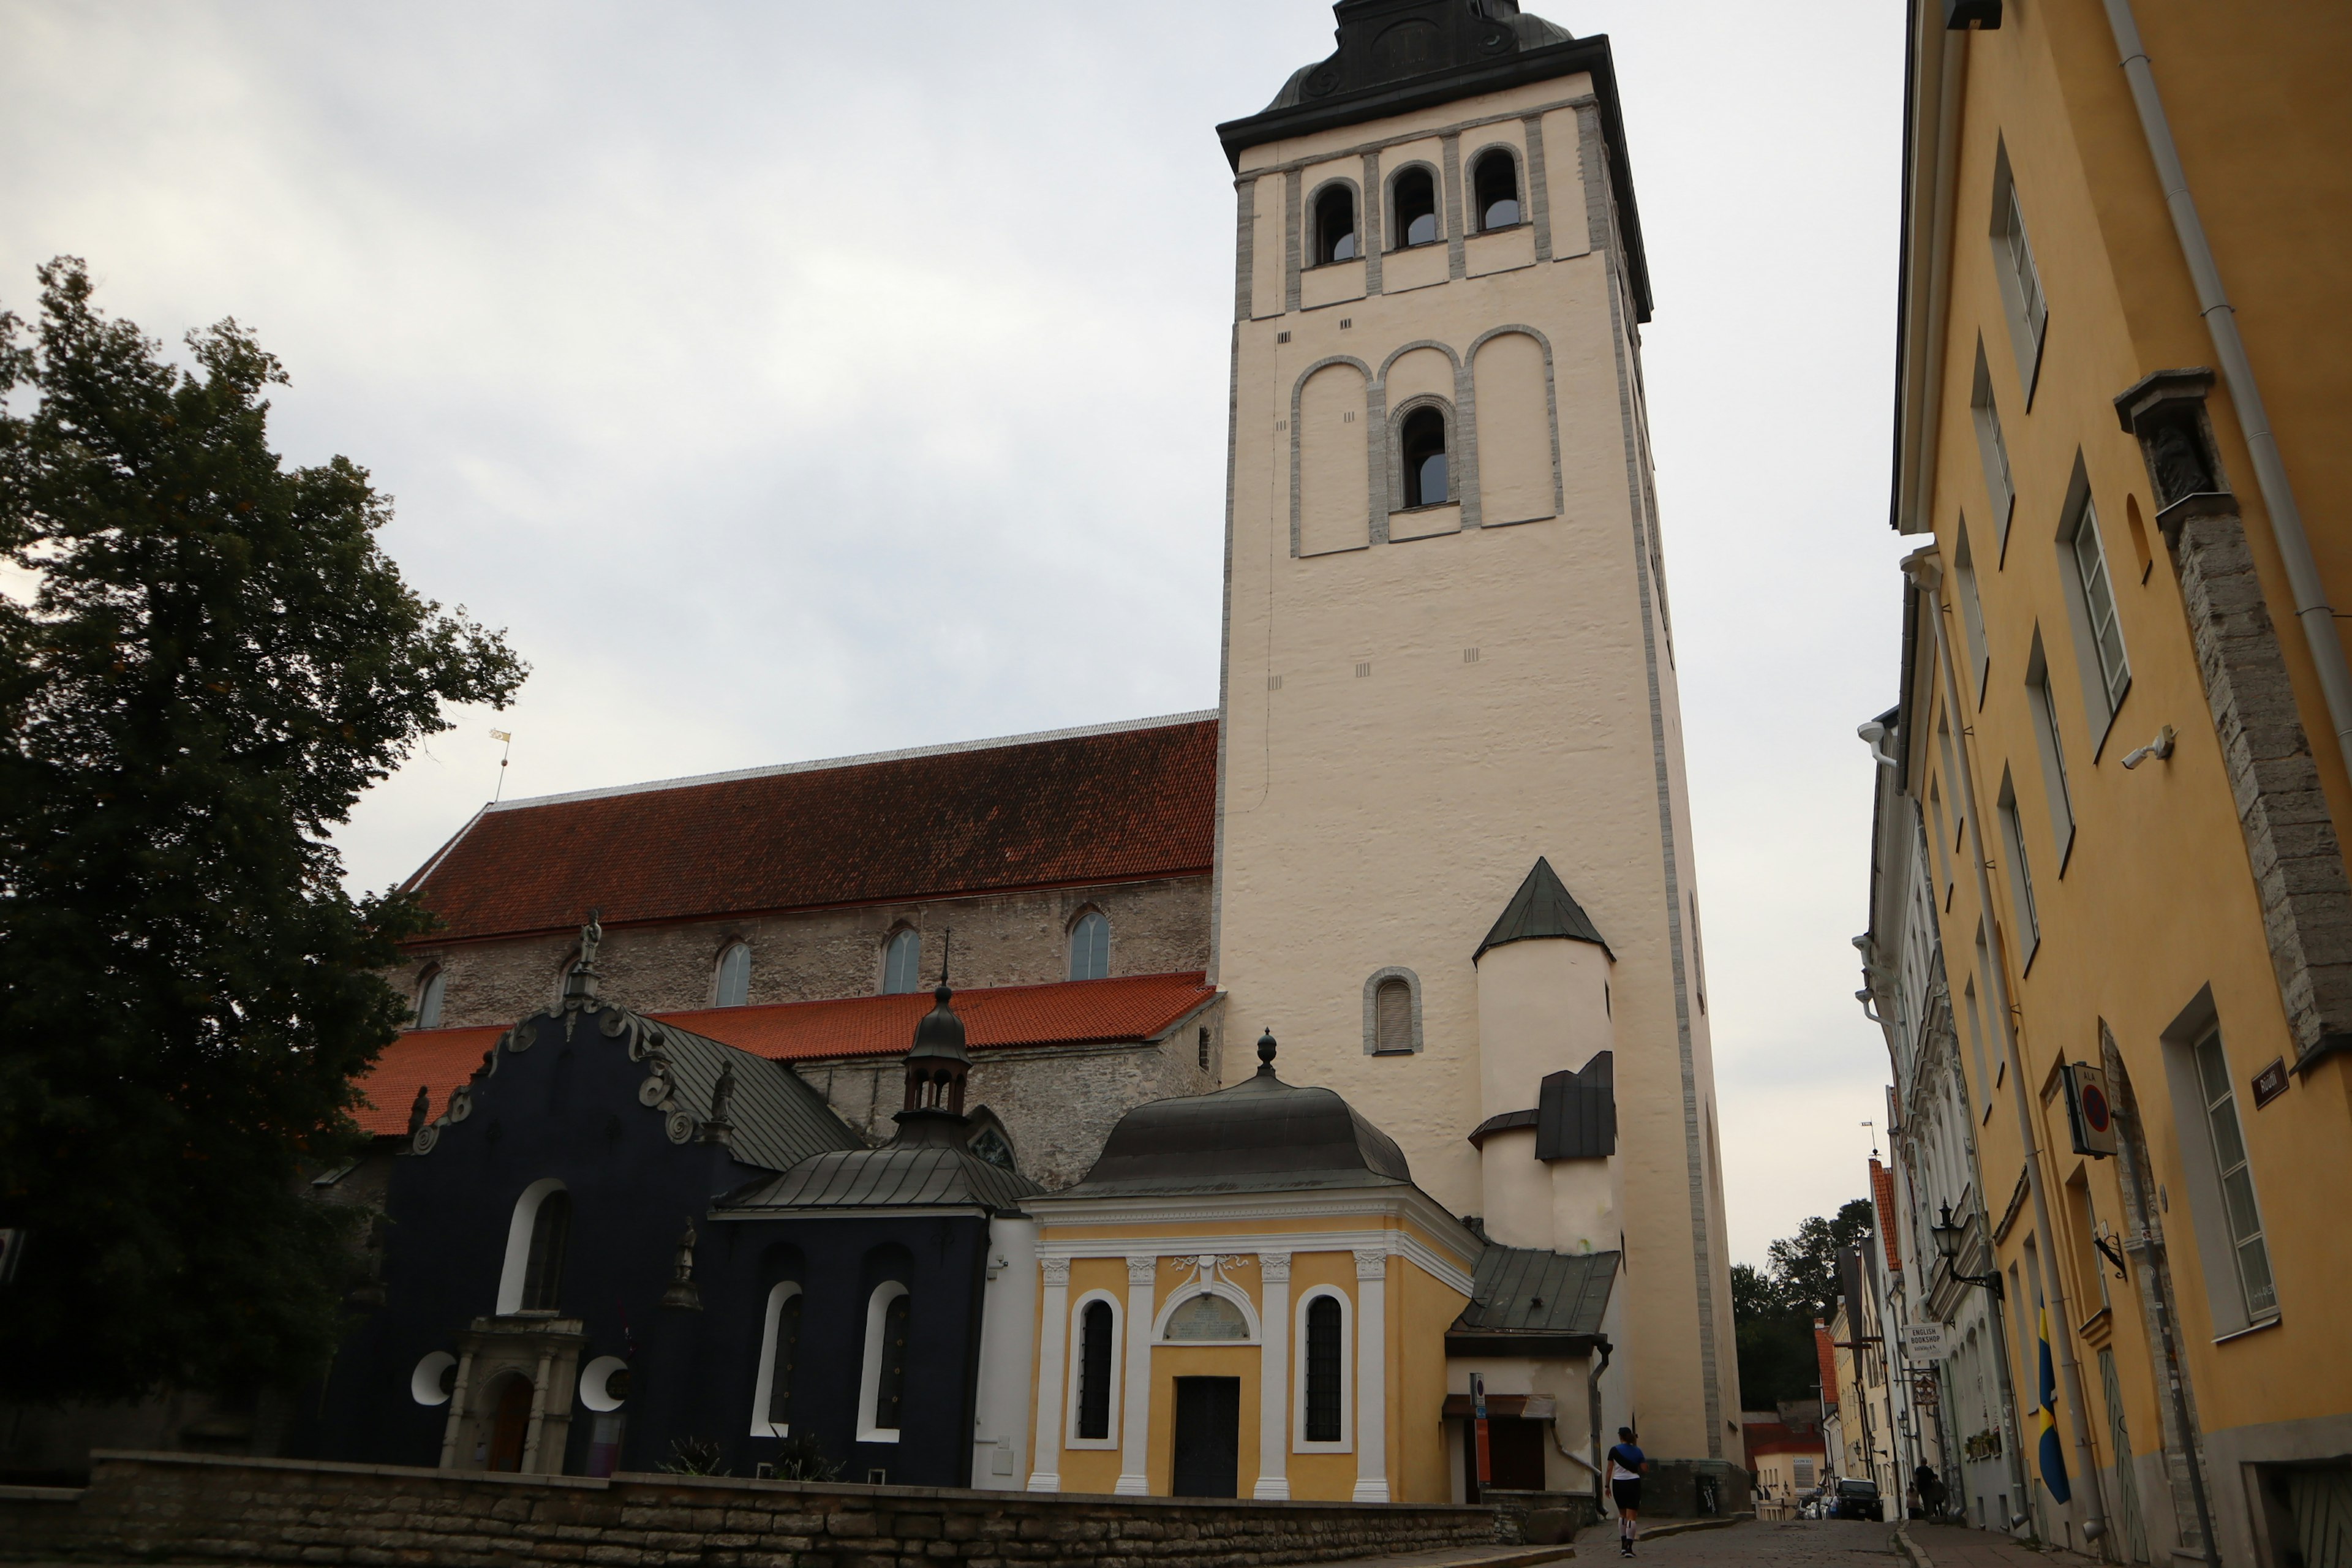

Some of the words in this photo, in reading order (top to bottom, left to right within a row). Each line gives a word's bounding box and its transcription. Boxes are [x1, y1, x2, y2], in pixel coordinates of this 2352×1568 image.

[2084, 1071, 2096, 1082] ALA
[2260, 1070, 2278, 1095] Rüütli
[1912, 1328, 1936, 1336] ENGLISH
[1910, 1335, 1940, 1344] BOOKSHOP
